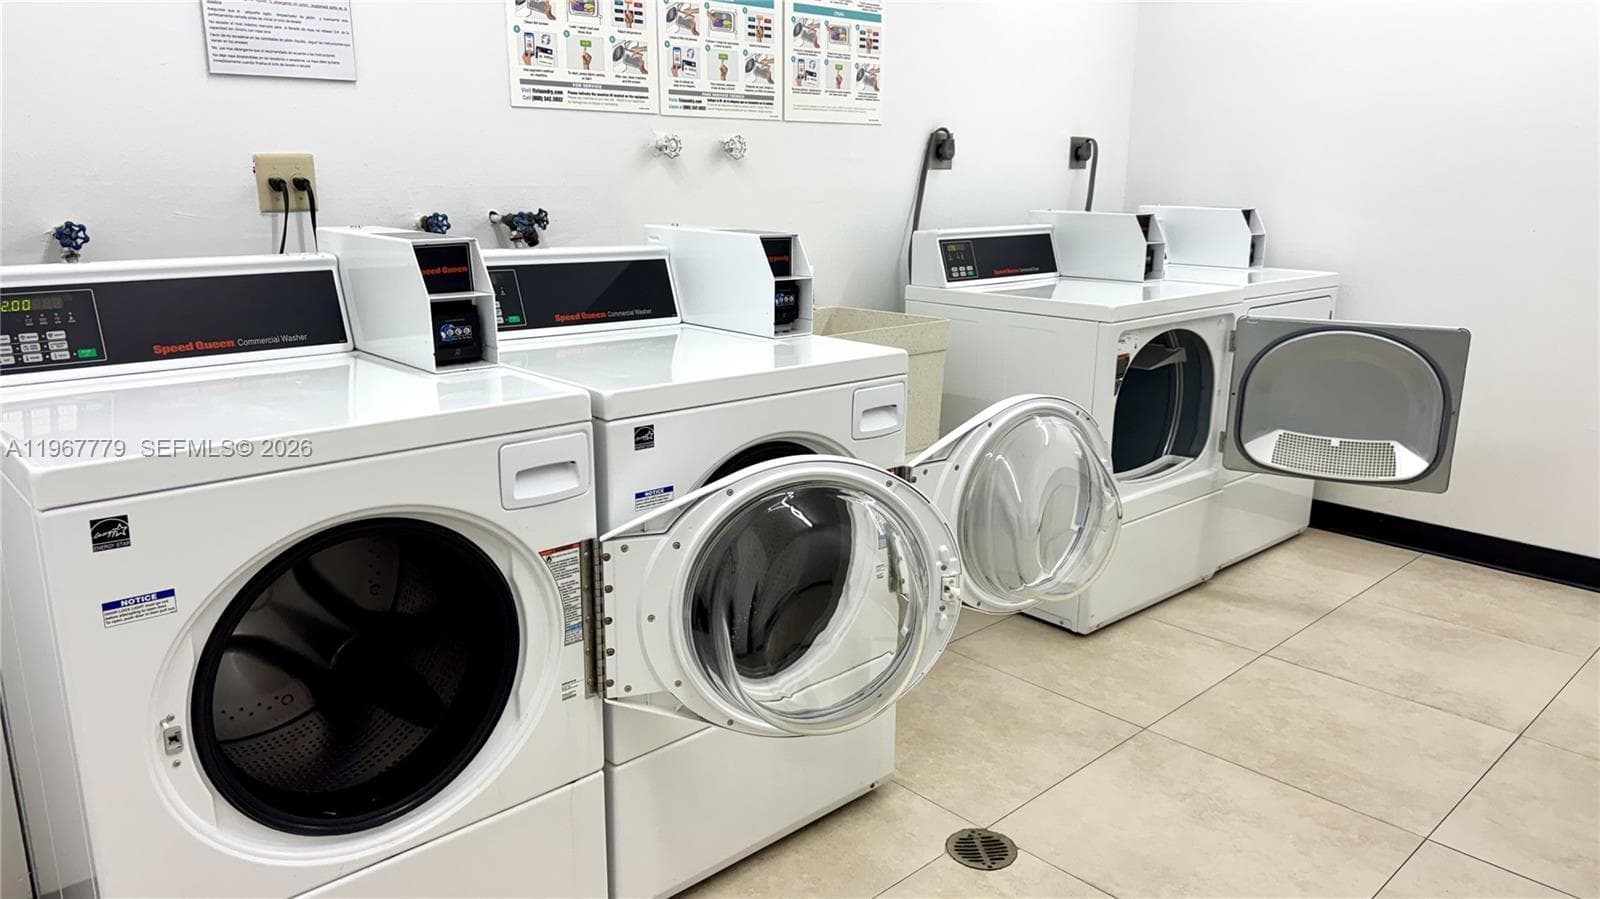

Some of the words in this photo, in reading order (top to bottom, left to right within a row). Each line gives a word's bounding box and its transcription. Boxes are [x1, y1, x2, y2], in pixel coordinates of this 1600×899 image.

[554, 312, 580, 322] Speed
[153, 341, 194, 355] Speed
[196, 339, 236, 350] Queen
[237, 336, 279, 347] Commercial
[281, 333, 307, 343] Washer
[120, 593, 158, 606] NOTICE
